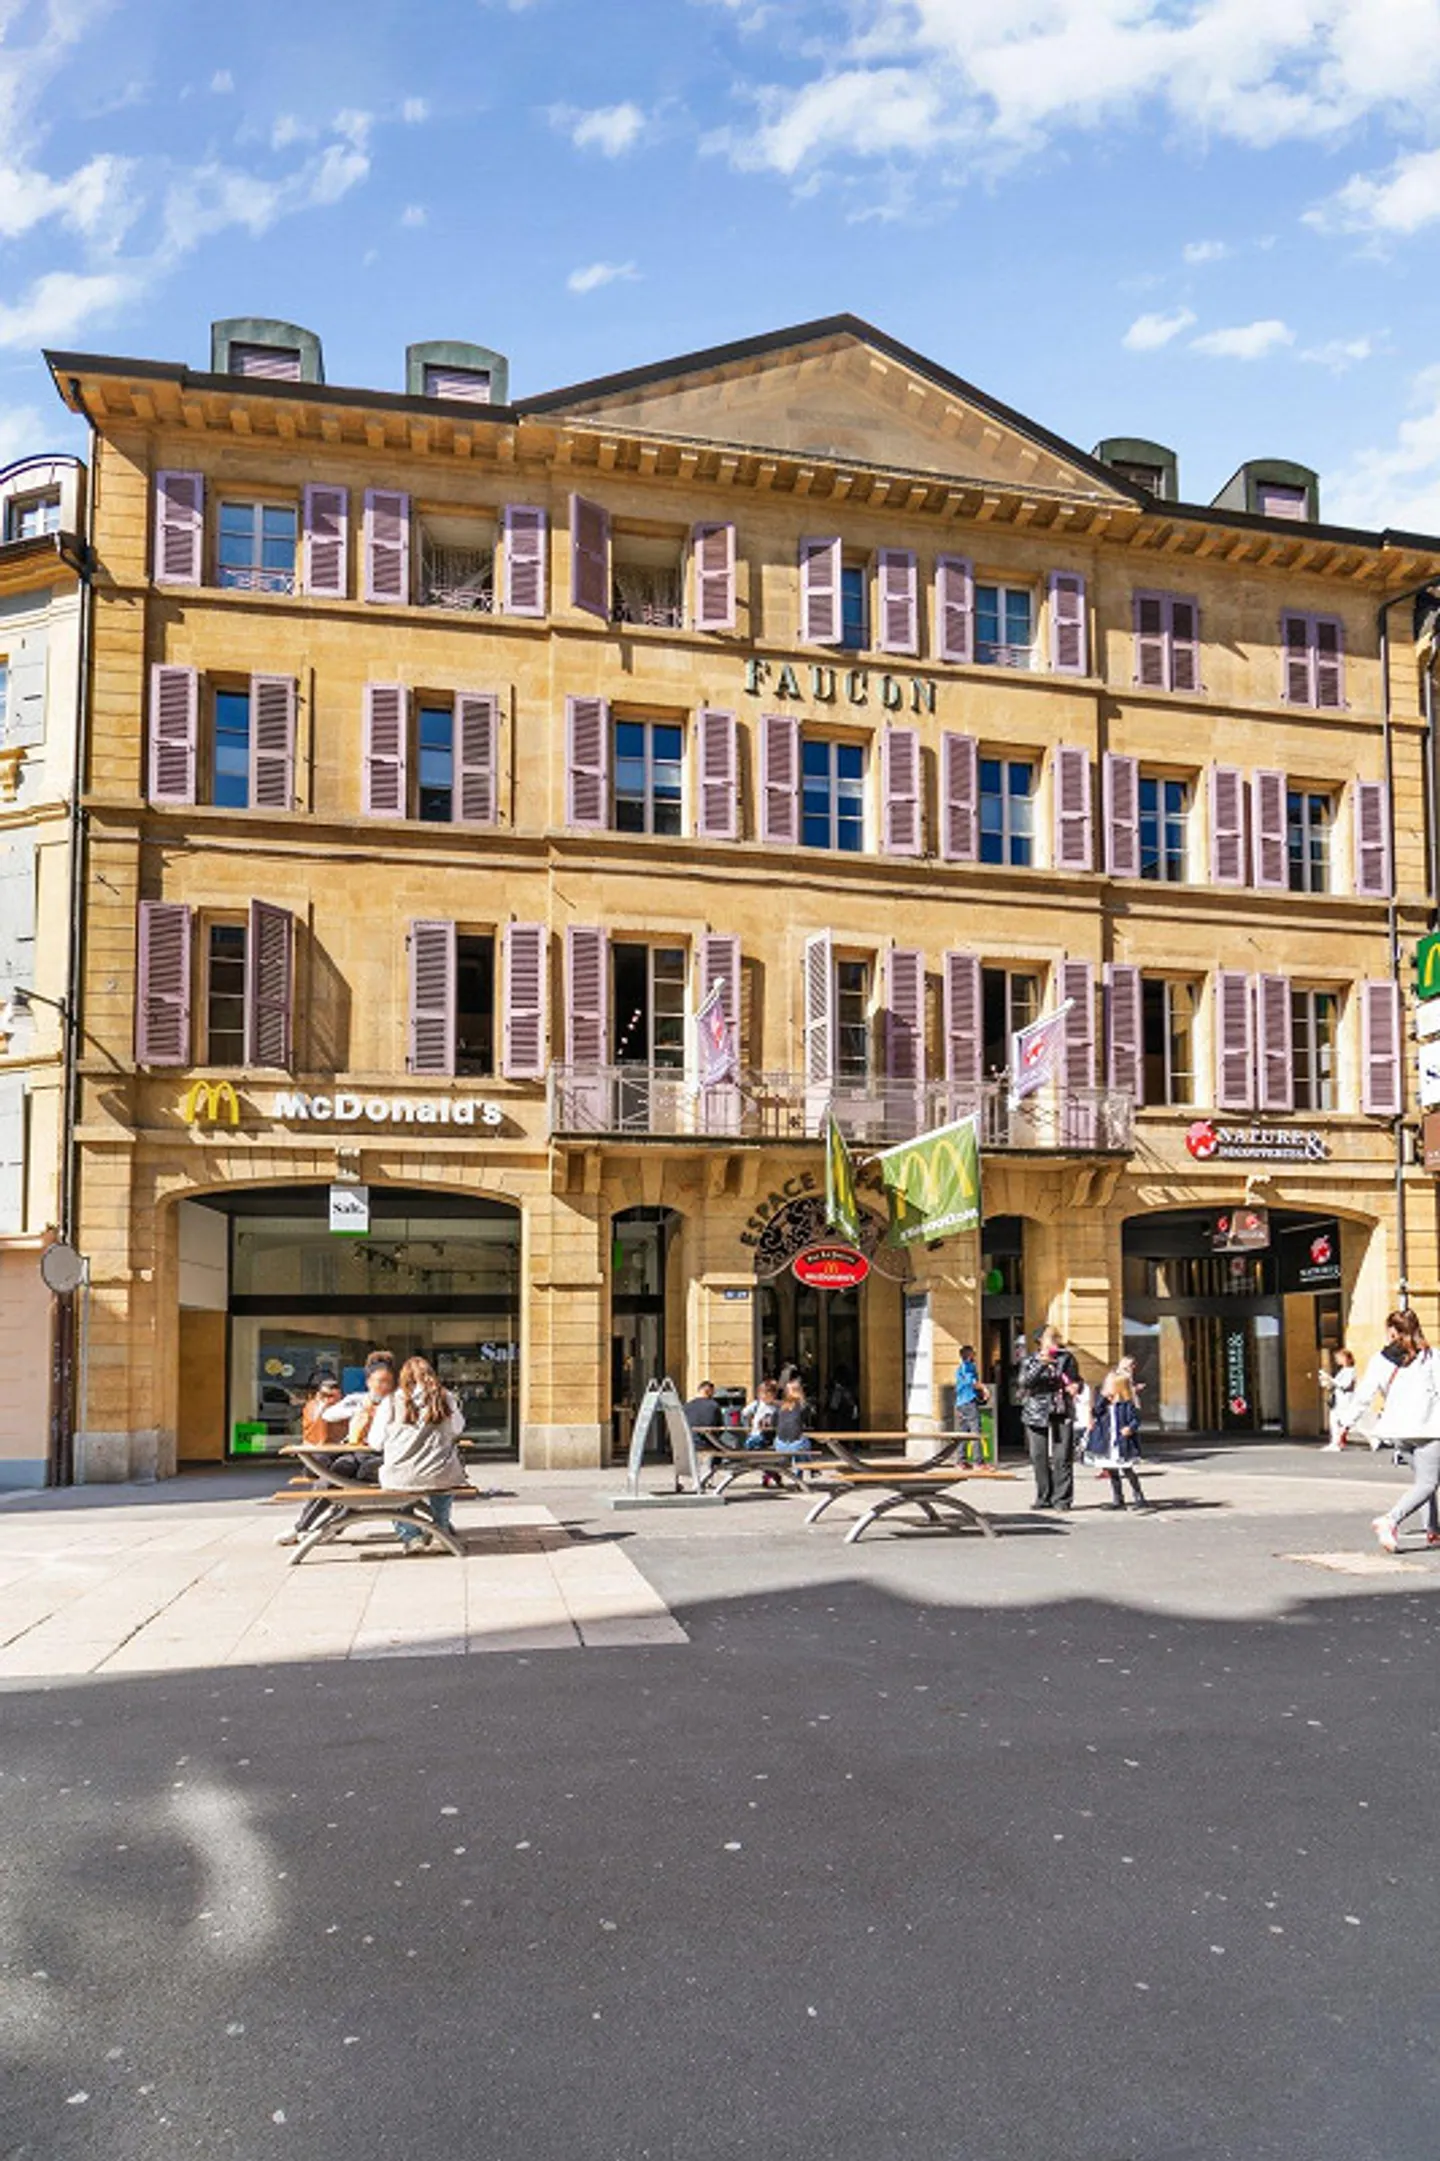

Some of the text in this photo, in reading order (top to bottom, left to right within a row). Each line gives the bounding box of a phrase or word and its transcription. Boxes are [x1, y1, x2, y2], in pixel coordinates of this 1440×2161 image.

[743, 658, 938, 713] FAUCON
[273, 1090, 504, 1126] McDonald's
[739, 1171, 818, 1247] ESPACE
[480, 1342, 519, 1362] Sal
